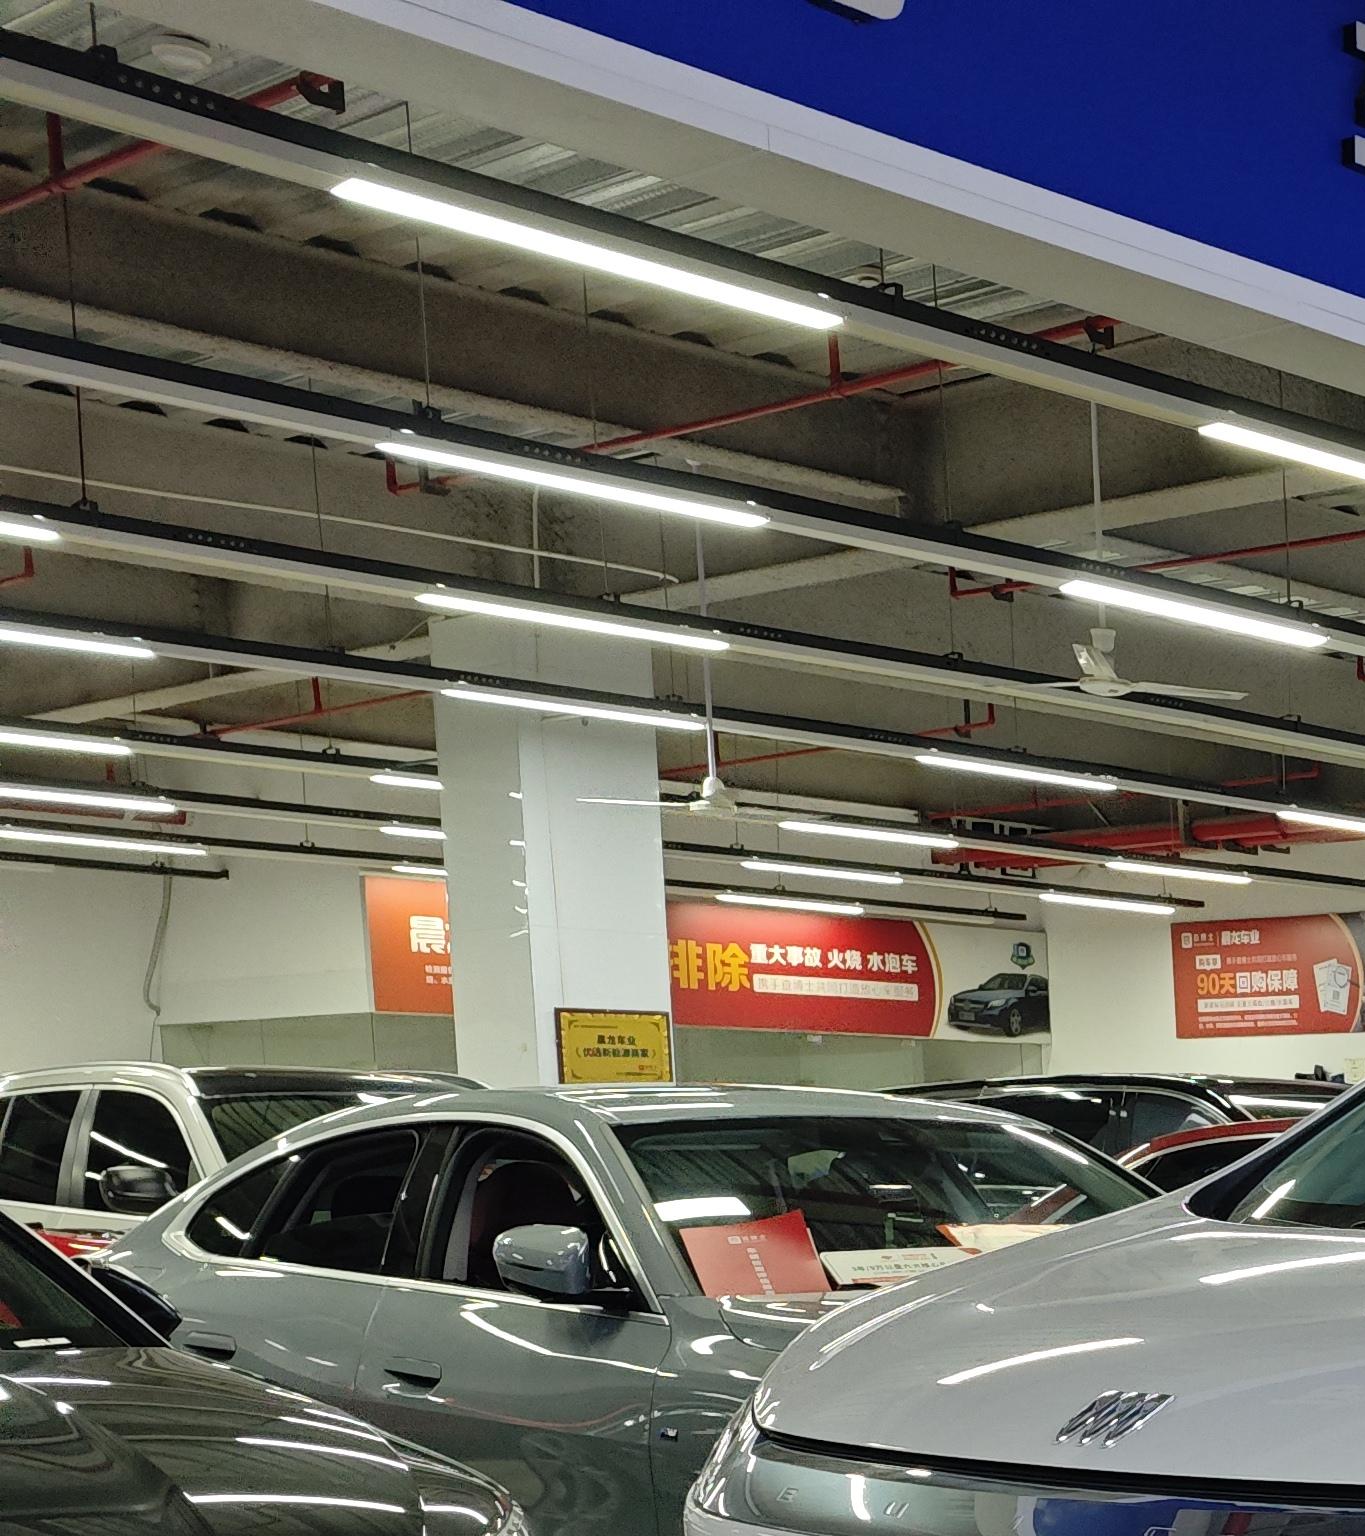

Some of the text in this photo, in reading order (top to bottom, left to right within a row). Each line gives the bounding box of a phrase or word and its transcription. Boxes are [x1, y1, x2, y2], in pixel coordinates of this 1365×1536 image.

[408, 914, 452, 955] 晨
[749, 943, 823, 969] 重大事故
[826, 948, 862, 970] 火烧
[866, 952, 918, 975] 水泡车
[1196, 969, 1299, 995] 90天回购保障
